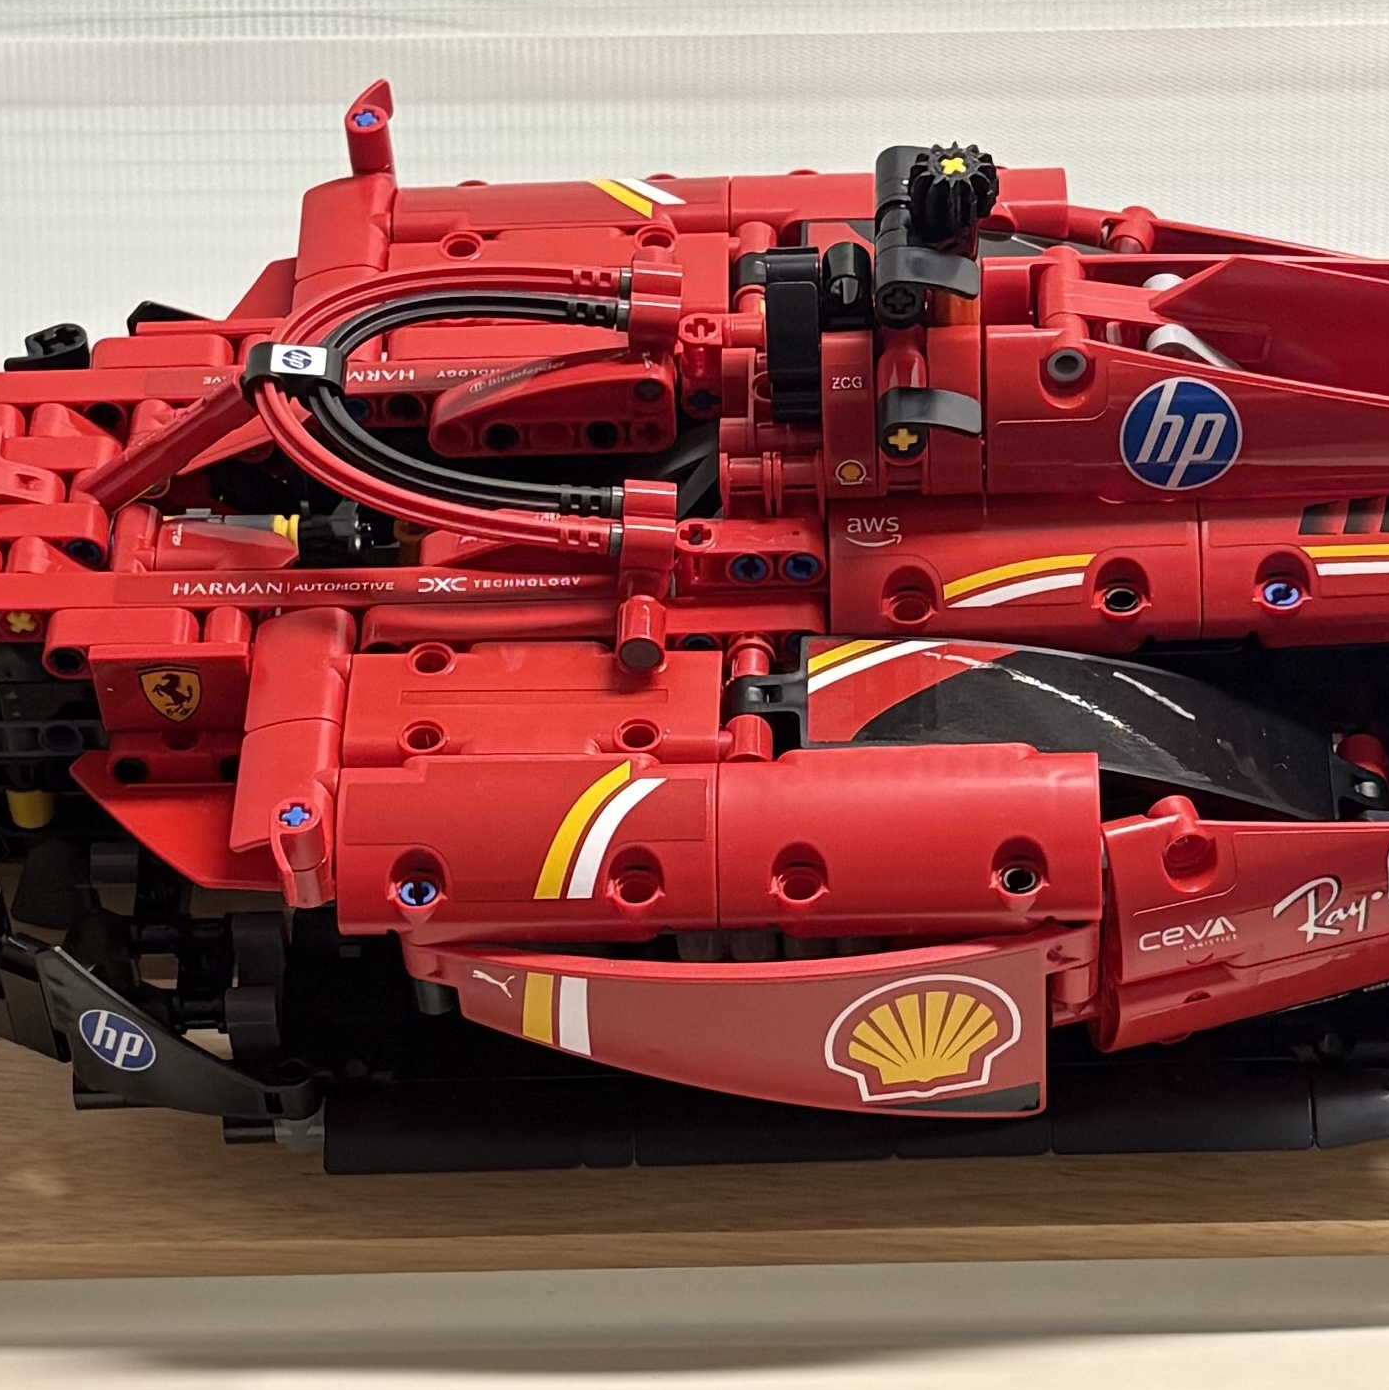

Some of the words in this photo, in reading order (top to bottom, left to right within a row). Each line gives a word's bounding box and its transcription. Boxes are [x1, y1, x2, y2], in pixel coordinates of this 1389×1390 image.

[1119, 376, 1243, 490] hp
[846, 516, 900, 534] aws
[172, 581, 283, 596] HARMAN
[79, 1010, 156, 1071] hp
